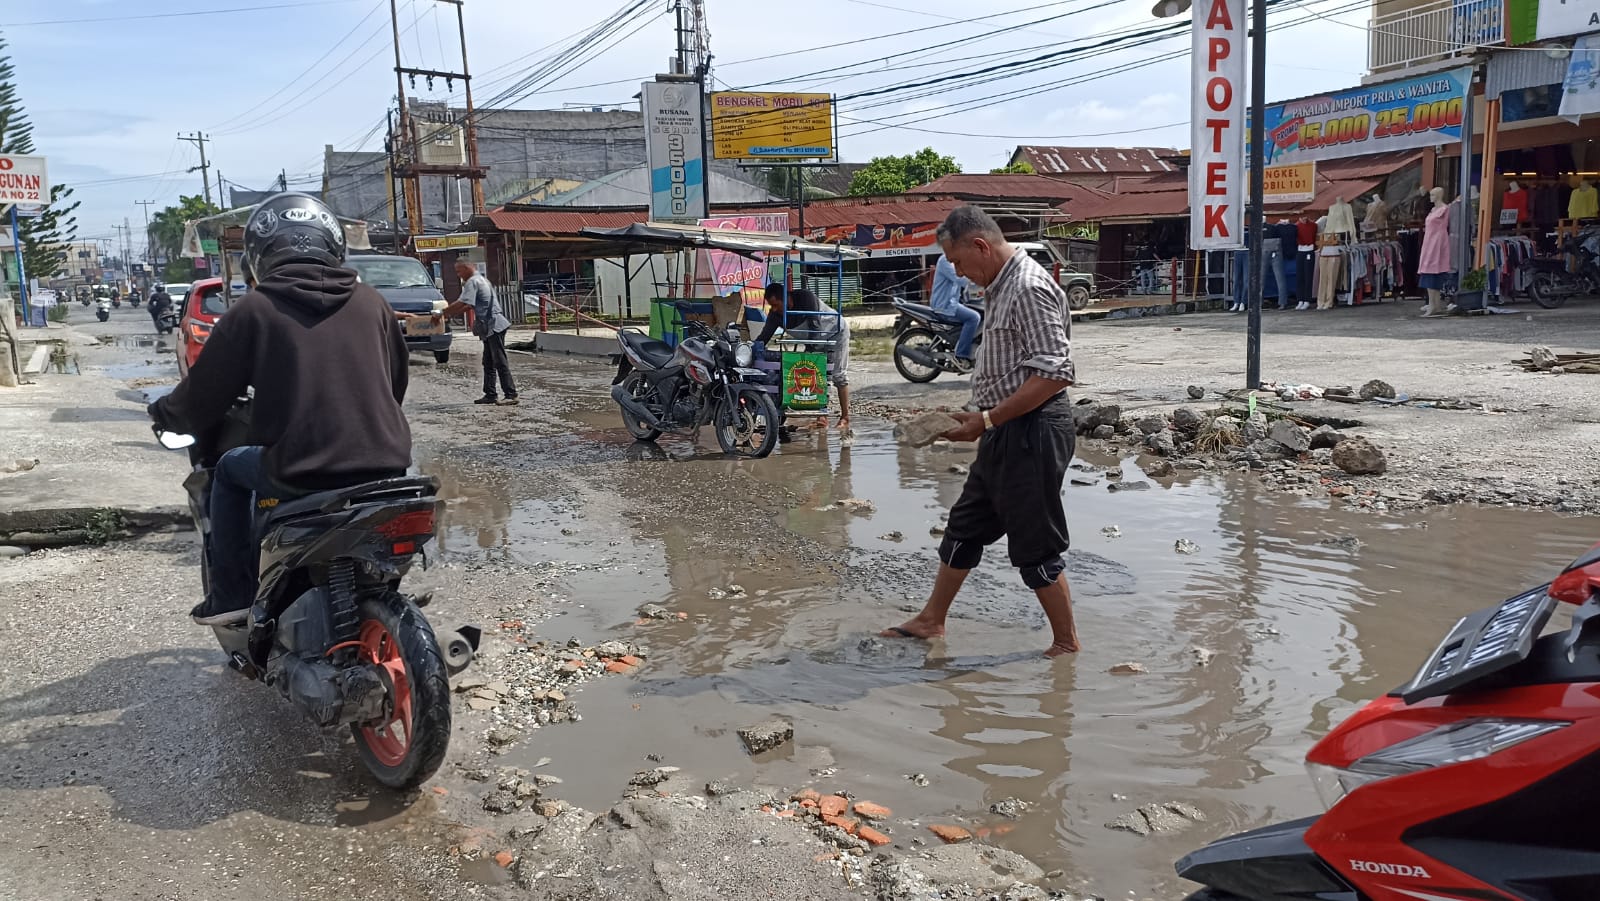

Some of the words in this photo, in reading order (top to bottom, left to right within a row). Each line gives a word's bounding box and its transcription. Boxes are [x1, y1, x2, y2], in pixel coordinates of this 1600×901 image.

[716, 96, 768, 107] BENGKEL
[773, 97, 804, 108] MOBIL
[1292, 101, 1330, 119] PAKAIAN
[1332, 93, 1370, 113] IMPORT
[1371, 90, 1396, 105] PRIA
[1398, 88, 1406, 99] &
[1408, 79, 1451, 98] WANITA
[1204, 0, 1233, 238] APOTEK
[0, 173, 40, 190] GUNAN
[668, 133, 687, 215] 35000
[1266, 169, 1300, 178] NGKEL
[1263, 181, 1286, 190] OBIL
[1290, 180, 1306, 189] 101
[10, 191, 24, 200] NO
[27, 191, 39, 200] 22
[885, 248, 911, 256] BENGKEL
[720, 265, 763, 285] PROMO
[1349, 859, 1432, 878] HONDA
